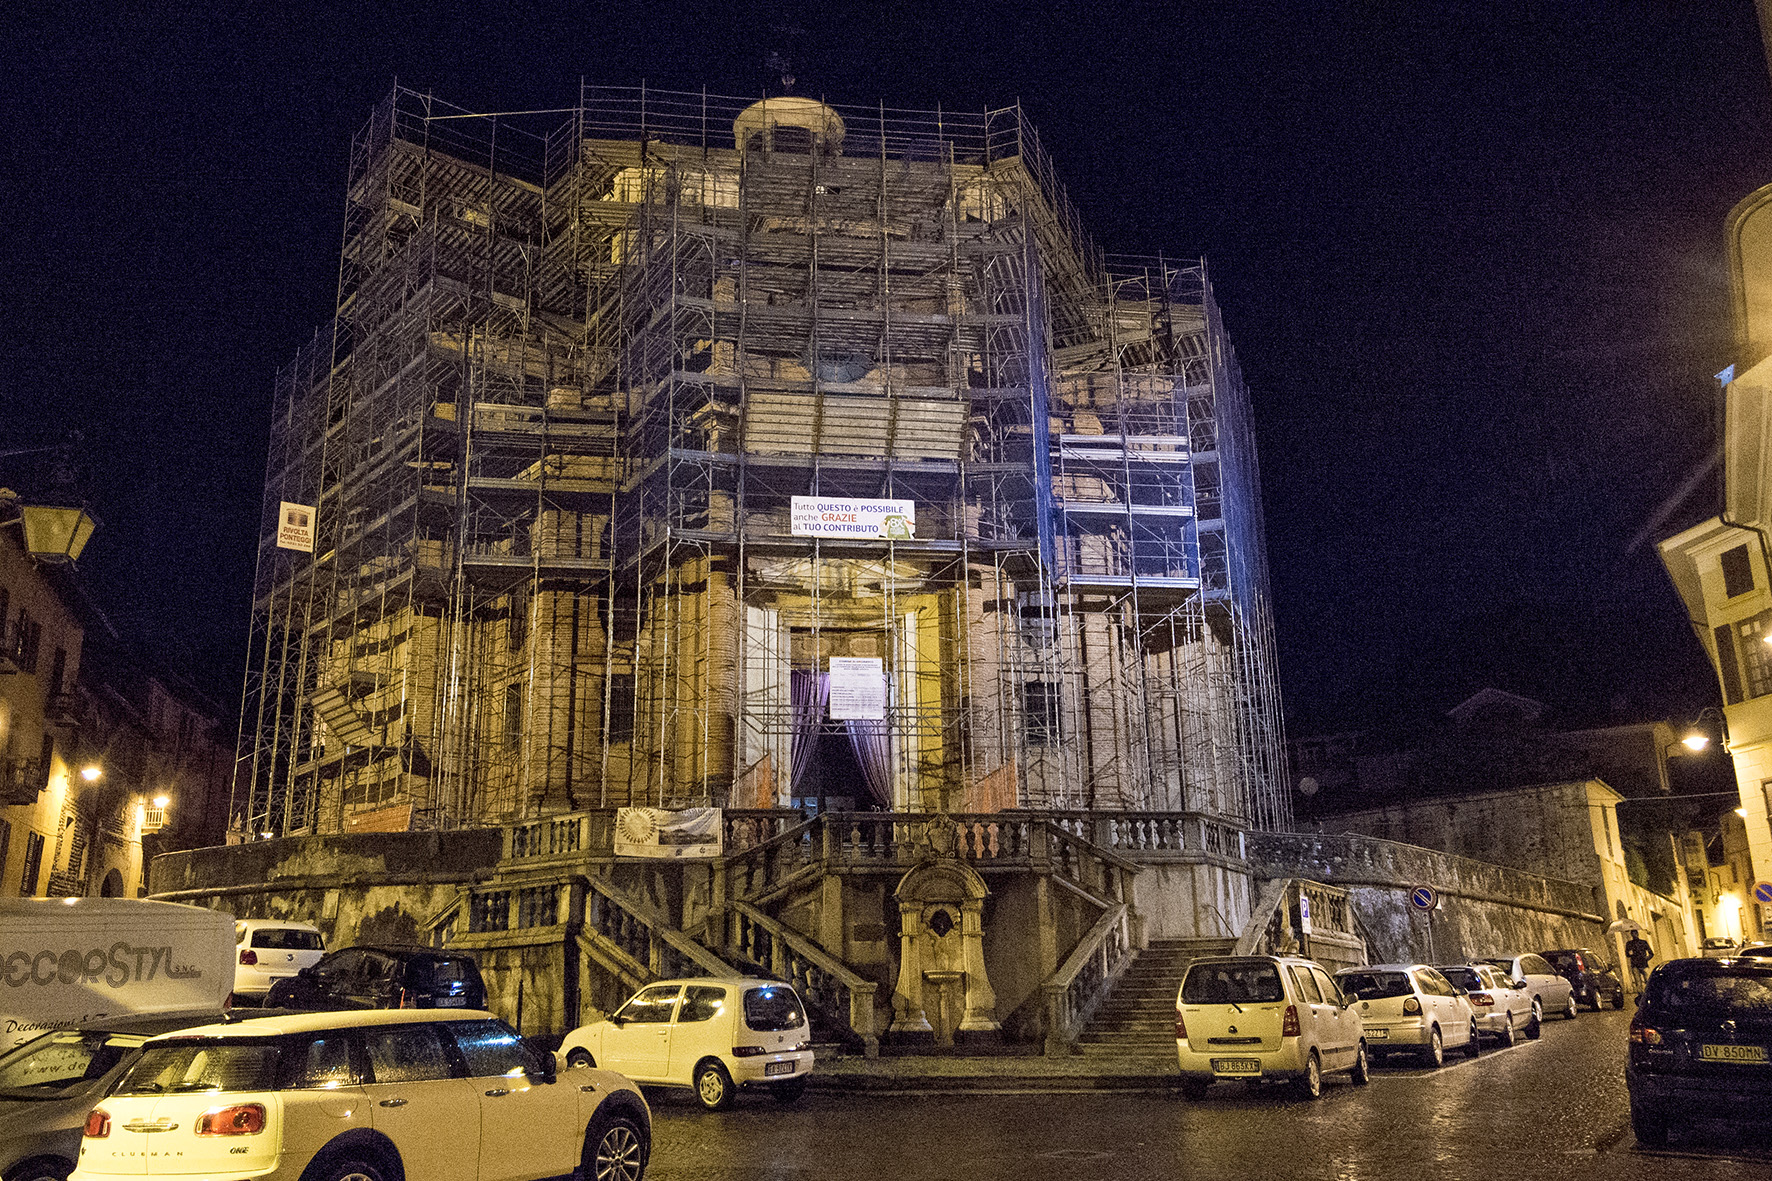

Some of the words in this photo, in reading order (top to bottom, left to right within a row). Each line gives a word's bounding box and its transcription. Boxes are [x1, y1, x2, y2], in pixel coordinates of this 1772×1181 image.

[793, 502, 815, 511] Tutto
[817, 503, 852, 512] QUESTO
[861, 505, 904, 513] POSSIBILE
[793, 512, 819, 521] anche
[821, 513, 857, 522] GRAZIE
[283, 526, 309, 537] RIVOLTA
[803, 523, 822, 531] TUO
[823, 524, 879, 533] CONTRIBUTO
[280, 533, 312, 544] PONTEGGI
[0, 941, 201, 988] ECORSTYL
[5, 1018, 76, 1034] Decorazioni
[1704, 1046, 1718, 1057] DV
